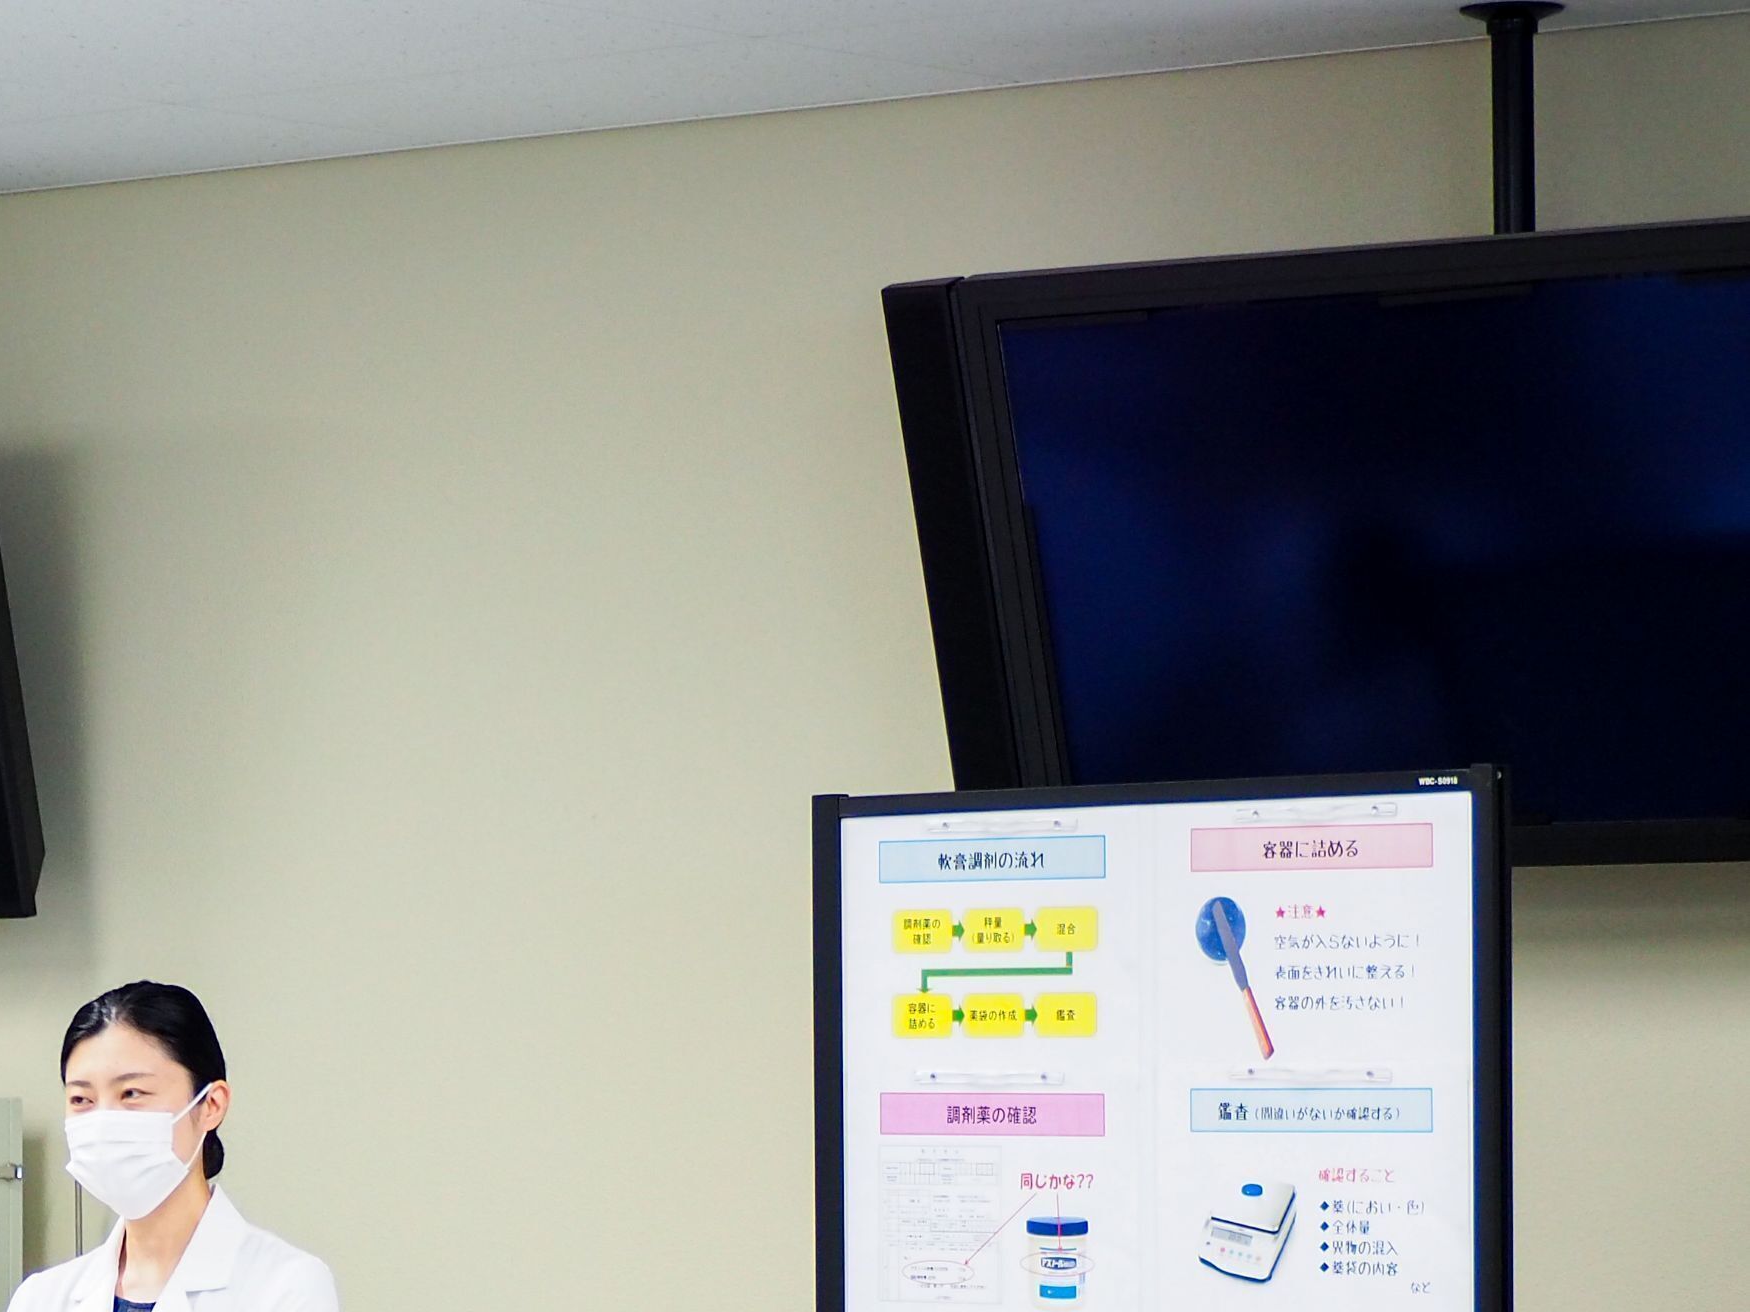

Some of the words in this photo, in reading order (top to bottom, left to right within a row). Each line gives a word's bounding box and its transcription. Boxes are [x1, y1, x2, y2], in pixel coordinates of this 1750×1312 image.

[1263, 839, 1359, 859] 容器に詰める
[937, 851, 1046, 871] 軟膏調剤の流れ
[903, 918, 941, 930] 調剤薬の
[1056, 923, 1076, 935] 混合
[913, 933, 932, 945] 確認
[908, 1003, 935, 1014] 容器に
[1056, 1009, 1076, 1021] 鑑査
[970, 1010, 1018, 1021] 薬袋の作成
[908, 1018, 936, 1029] 詰める
[946, 1105, 1038, 1125] 調剤薬の確認
[1020, 1173, 1094, 1190] 同じかな??
[1319, 1168, 1395, 1183] 確認すること
[1332, 1220, 1370, 1235] 全体量
[1332, 1240, 1399, 1255] 異物の混入
[1332, 1261, 1398, 1276] 薬袋の内容
[1410, 1282, 1431, 1294] など
